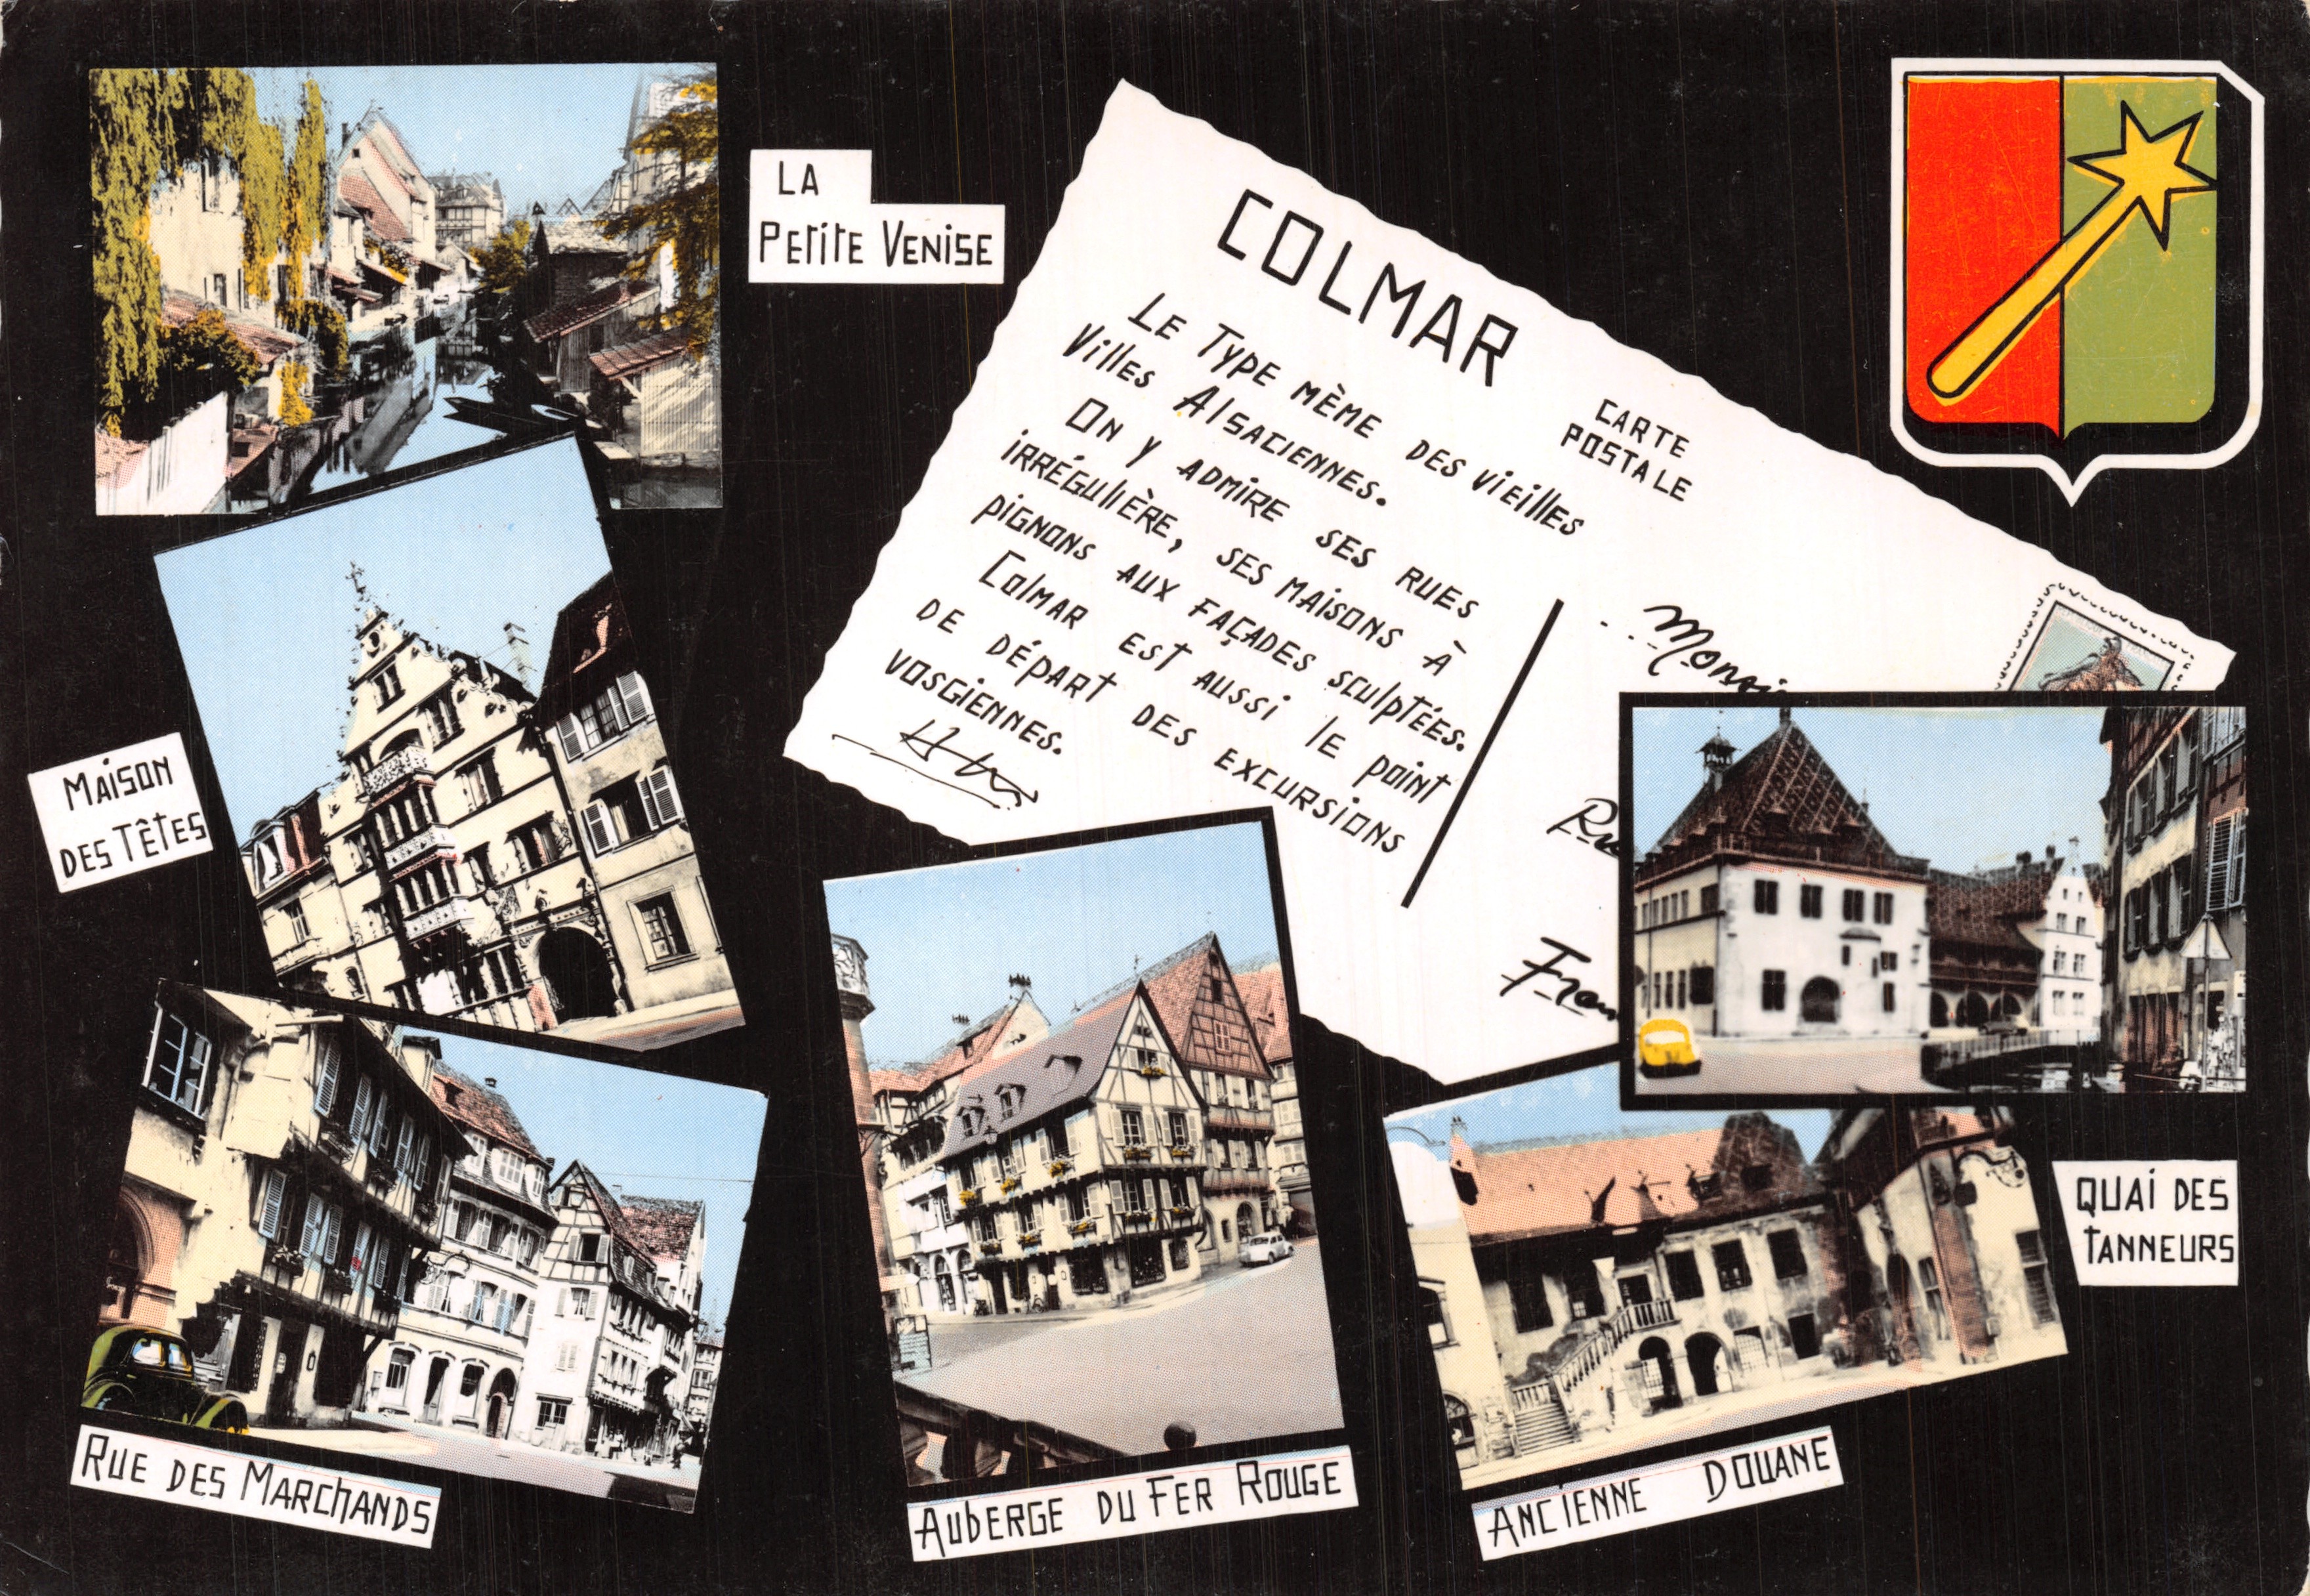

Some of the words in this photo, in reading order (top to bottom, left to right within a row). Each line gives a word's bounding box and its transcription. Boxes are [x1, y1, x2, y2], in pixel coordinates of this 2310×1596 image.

[779, 161, 818, 195] LA
[1218, 189, 1518, 387] COLMAR
[1128, 293, 1186, 339] LE
[1406, 440, 1465, 476] DES
[1561, 423, 1692, 501] POSTALE
[1595, 399, 1689, 457] CARTE
[1066, 398, 1123, 442] ON
[1316, 530, 1376, 567] SES
[1395, 567, 1479, 618] RUES
[1117, 564, 1179, 601] AUX
[1188, 598, 1316, 671] FAÇADES
[1217, 548, 1272, 585] SES
[1423, 640, 1466, 676] À
[917, 599, 964, 633] DE
[1132, 705, 1196, 746] DES
[60, 840, 112, 877] DES
[2175, 1179, 2228, 1211] DES
[82, 1434, 147, 1482] RUE
[167, 1460, 224, 1498] DES
[1097, 1490, 1135, 1524] DU
[1146, 1475, 1213, 1517] FER
[1236, 1460, 1341, 1505] ROUGE
[1703, 1436, 1830, 1503] DOUANE
